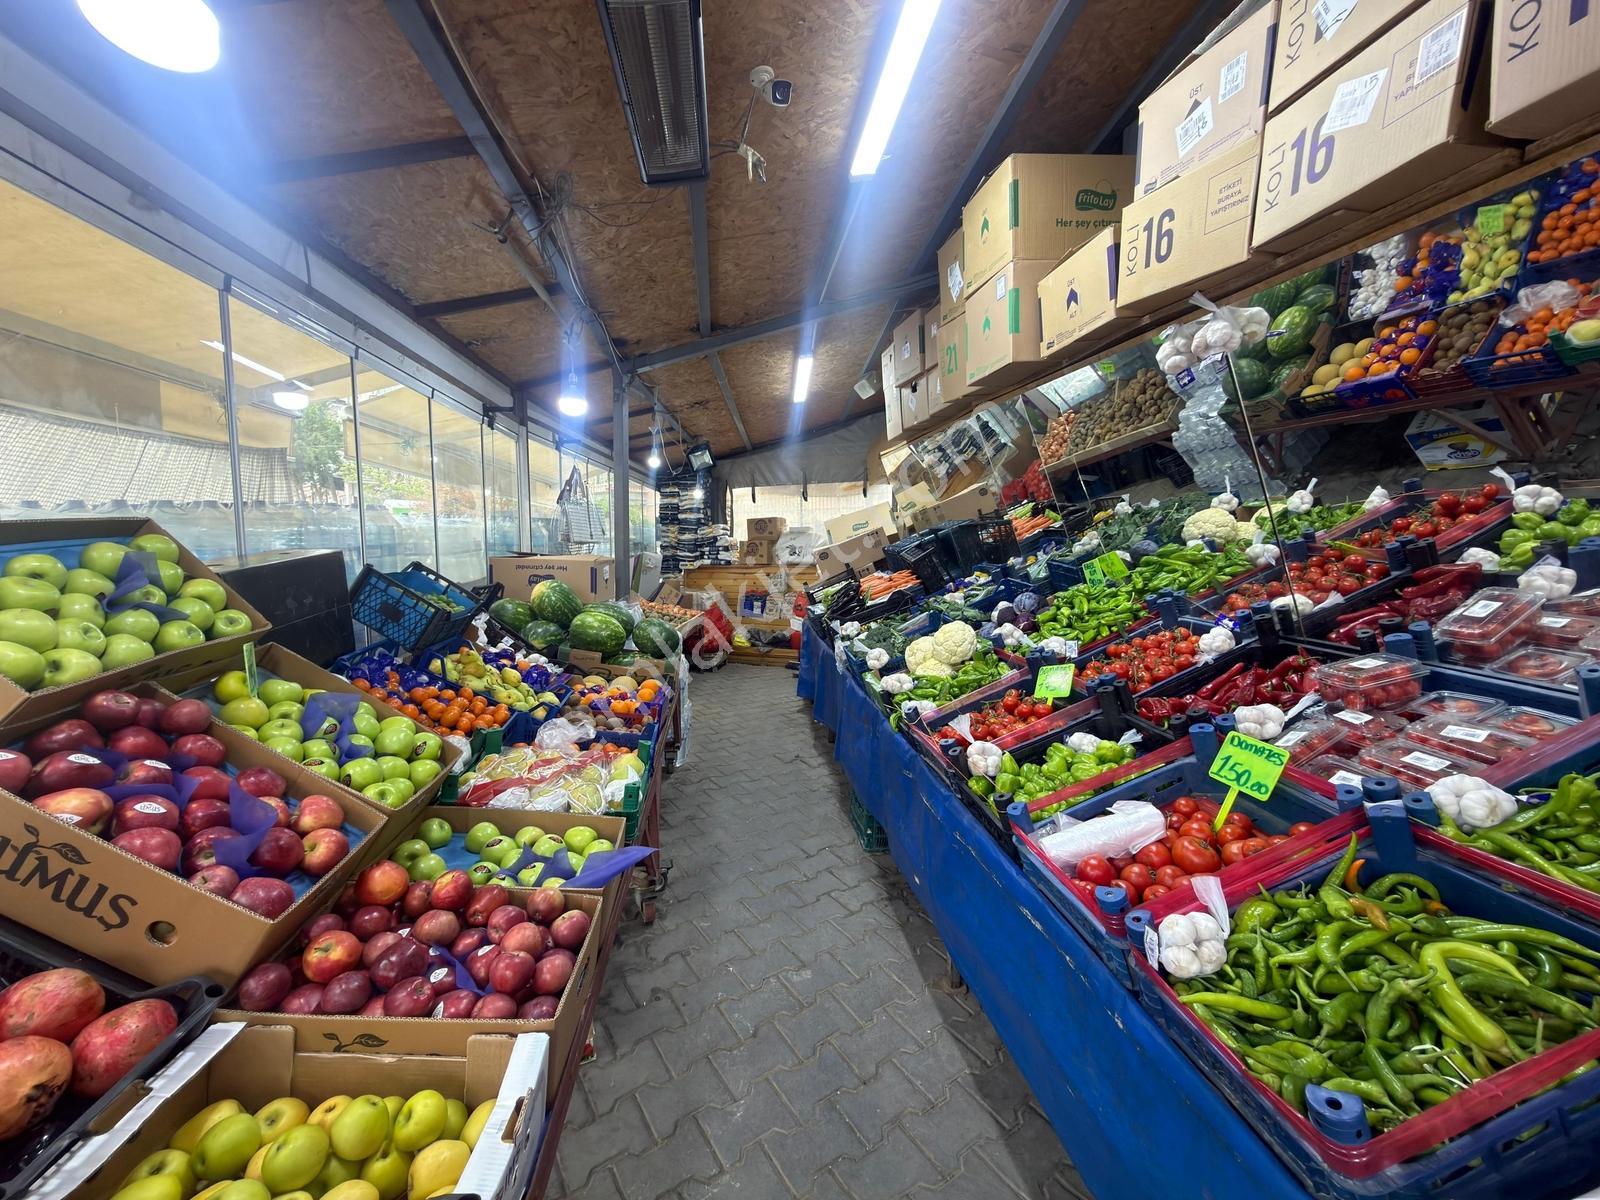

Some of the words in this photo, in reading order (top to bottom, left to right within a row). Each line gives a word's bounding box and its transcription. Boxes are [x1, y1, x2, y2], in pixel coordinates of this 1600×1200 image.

[1507, 0, 1542, 63] KO
[1264, 142, 1286, 213] KOLI
[1056, 218, 1073, 227] Her
[1075, 219, 1091, 229] şey
[1143, 208, 1176, 269] 16
[1126, 224, 1140, 277] KOLI
[946, 343, 959, 375] 21
[1229, 734, 1285, 766] DOMATES
[1210, 754, 1269, 795] 150.00
